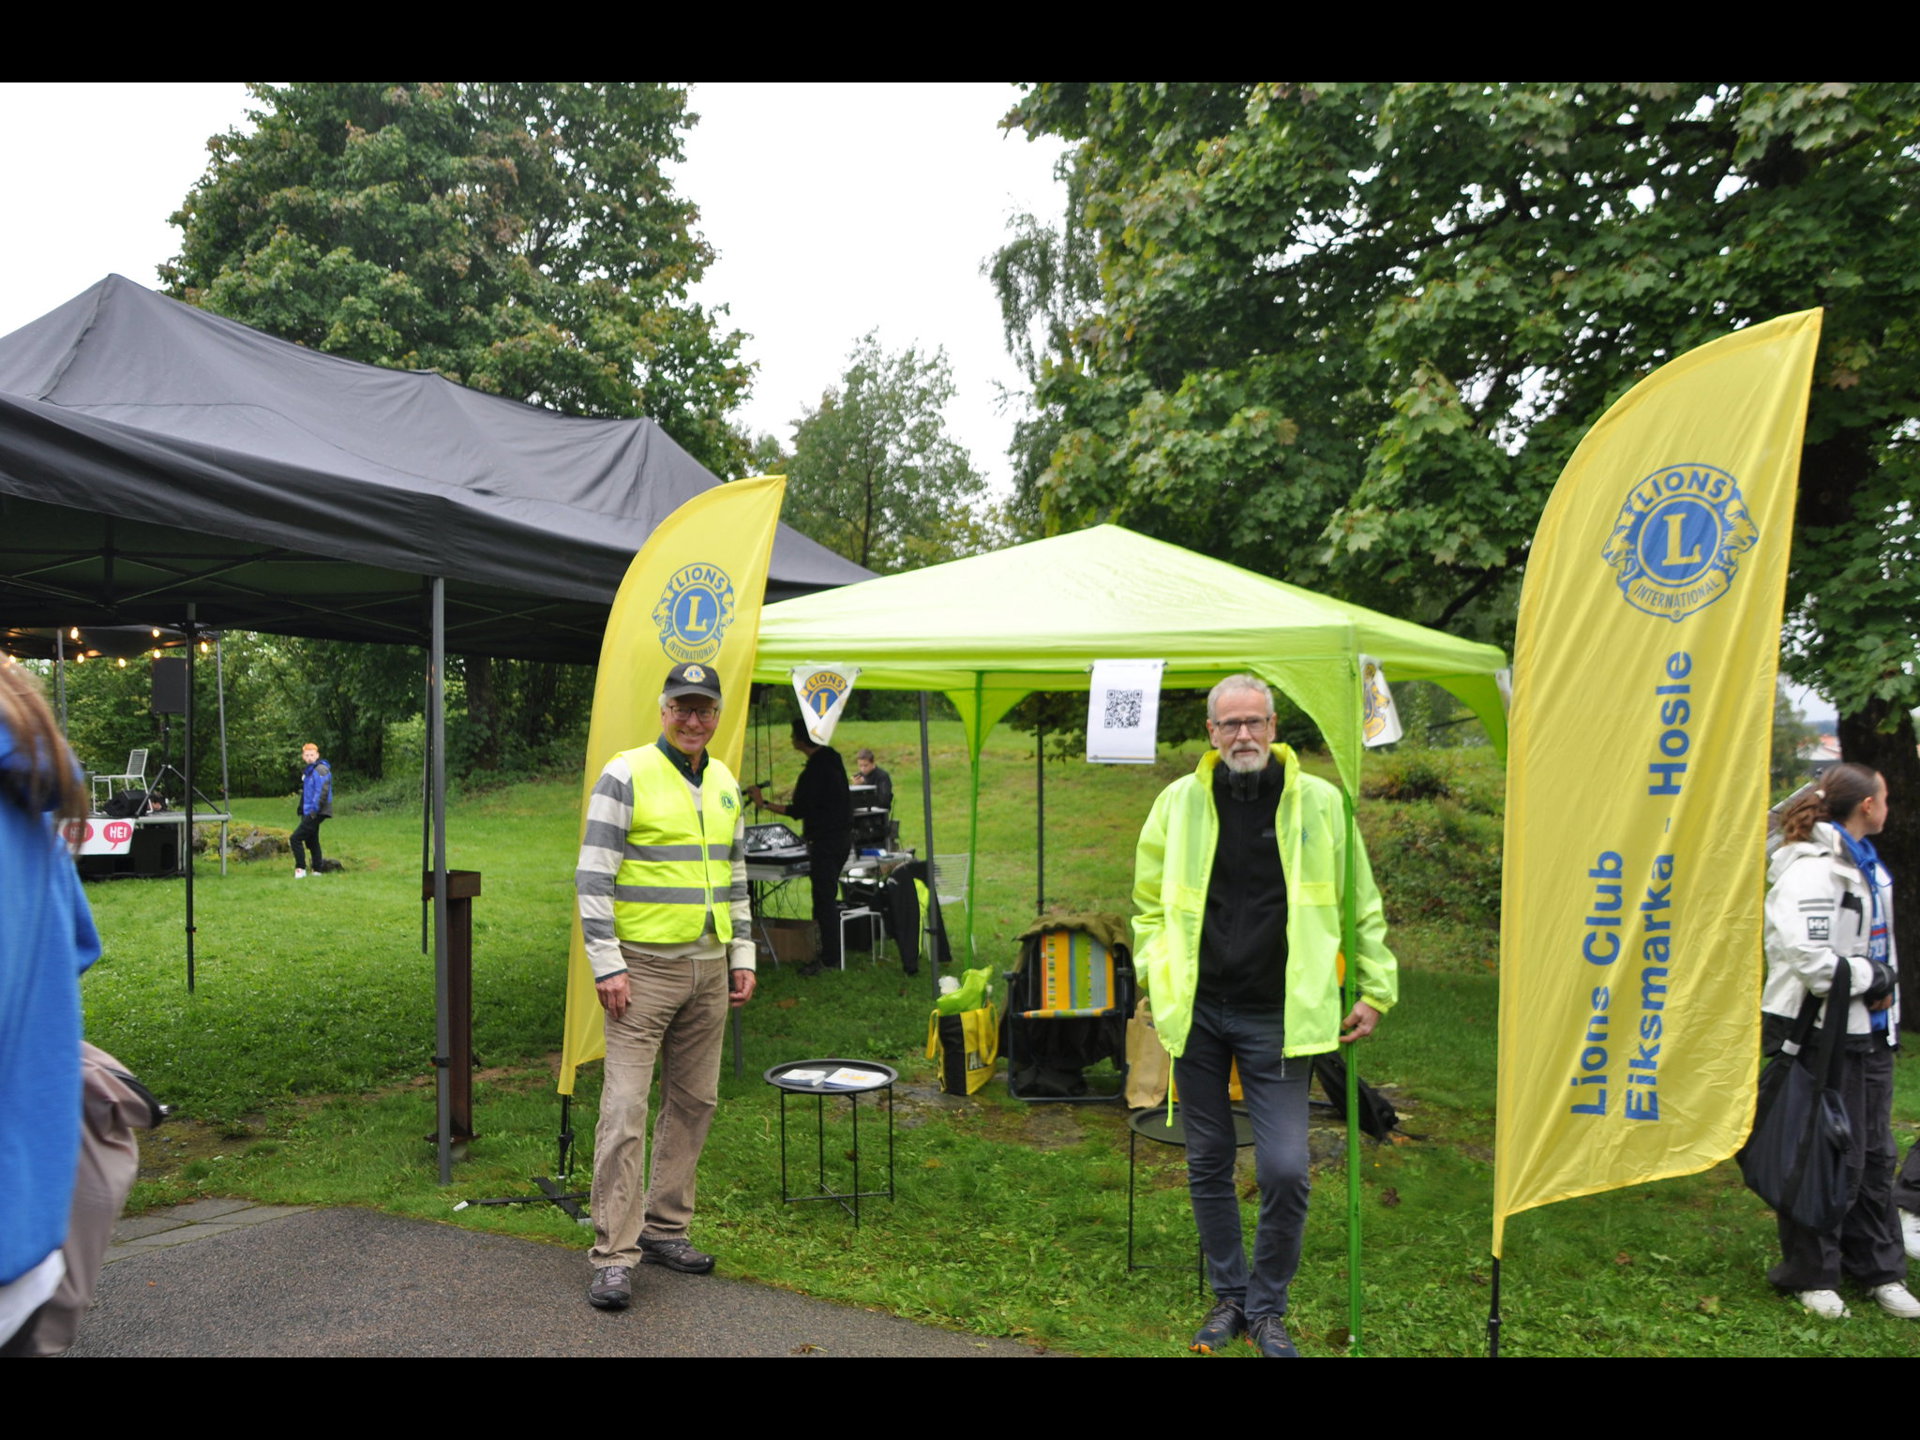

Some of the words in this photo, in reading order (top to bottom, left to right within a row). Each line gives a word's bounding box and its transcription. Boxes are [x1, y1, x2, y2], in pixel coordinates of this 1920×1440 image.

[1635, 470, 1728, 507] LIONS
[1661, 512, 1702, 567] L
[675, 567, 725, 589] LIONS
[1633, 577, 1722, 609] INTERNATIONAL
[685, 595, 707, 632] L
[667, 641, 716, 661] INTERNATIONAL
[808, 674, 843, 688] LIONS
[1648, 650, 1692, 796] Hosle
[109, 826, 128, 839] HEI
[1582, 849, 1624, 966] Club
[1808, 918, 1828, 930] HH
[1624, 853, 1675, 1121] Eiksmarka
[1570, 985, 1610, 1116] Lions
